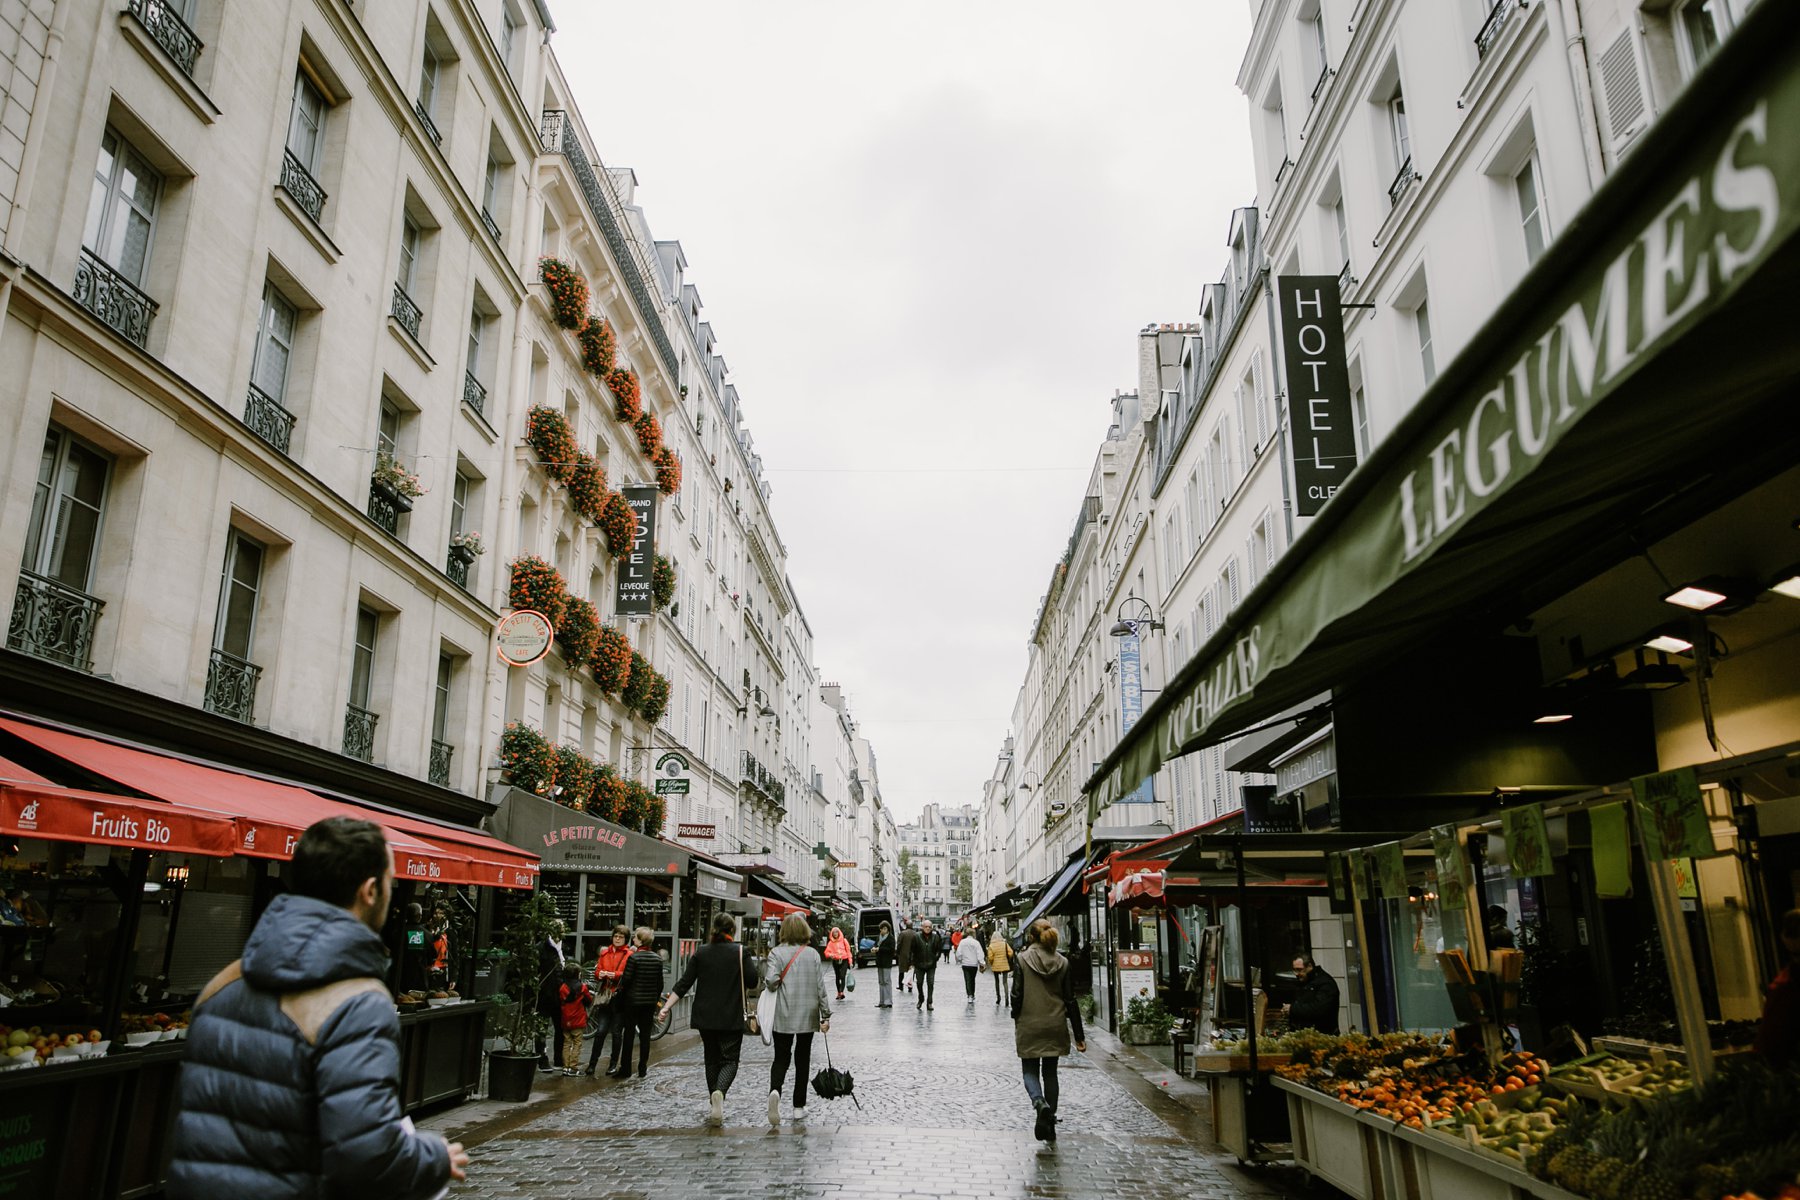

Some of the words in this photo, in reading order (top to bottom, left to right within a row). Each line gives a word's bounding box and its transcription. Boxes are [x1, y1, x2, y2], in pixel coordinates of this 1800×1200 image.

[1399, 99, 1779, 563] LEGUMES
[1295, 288, 1336, 470] HOTEL
[628, 499, 651, 507] GRAND
[1308, 484, 1342, 500] CLE
[629, 511, 649, 578] HOTEL
[620, 582, 650, 590] LEVEQUE
[1121, 641, 1138, 652] LA
[1122, 660, 1140, 730] SABLA
[91, 811, 139, 840] Fruits
[145, 818, 171, 844] Bio
[543, 830, 560, 847] LE
[560, 825, 596, 841] PETIT
[596, 828, 627, 850] CLER
[678, 826, 715, 837] FROMAGER
[406, 859, 427, 876] Fruits
[428, 862, 441, 878] Bio
[0, 1139, 46, 1168] GIQUES
